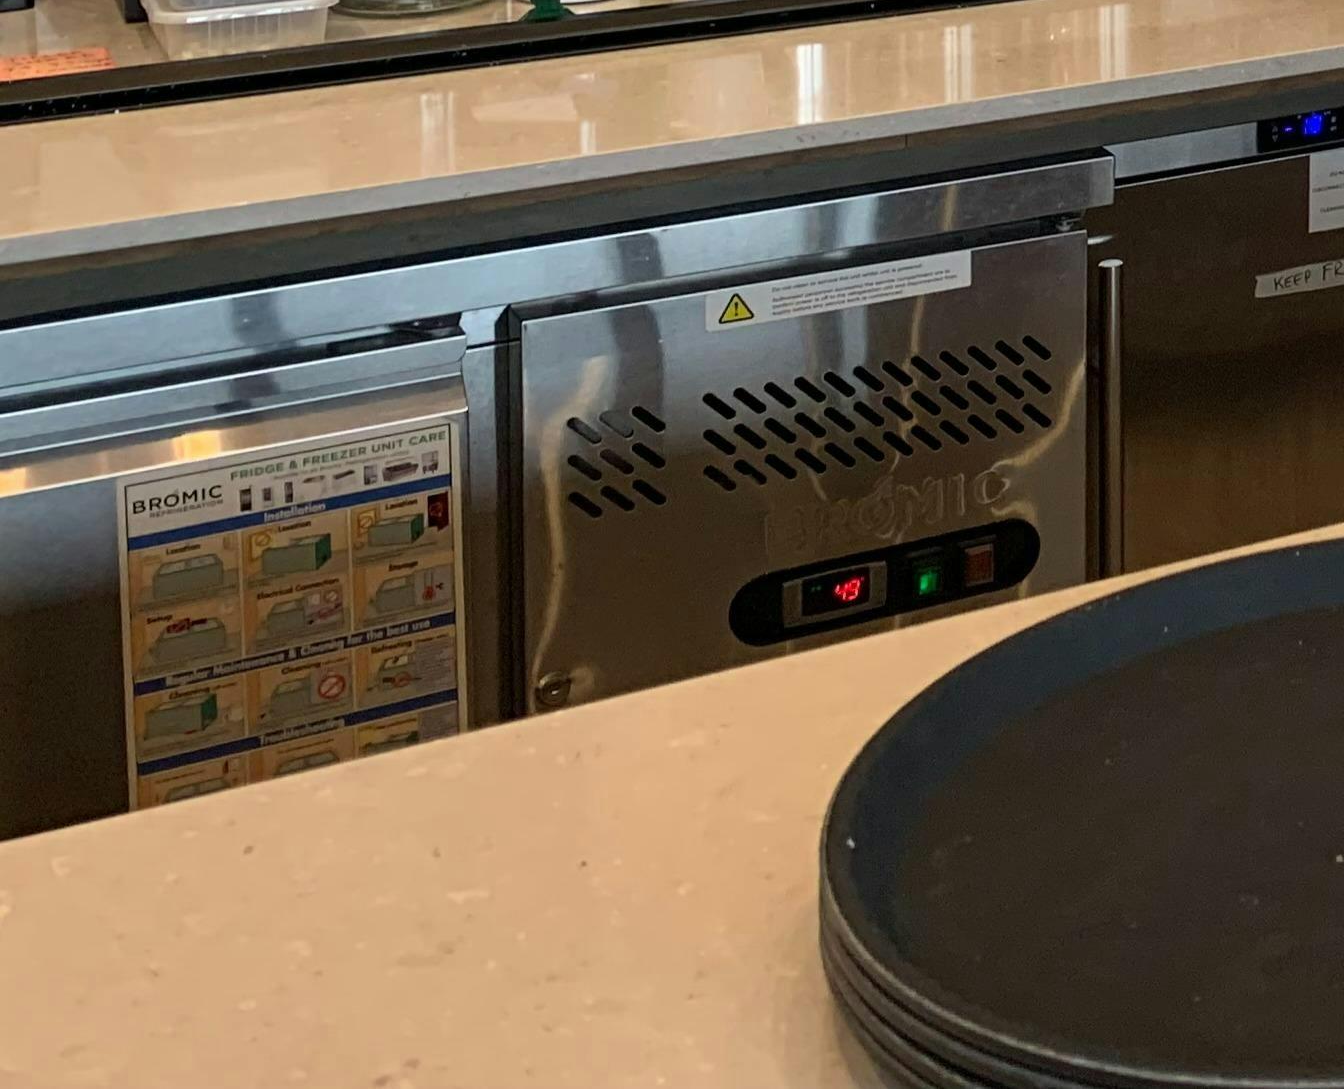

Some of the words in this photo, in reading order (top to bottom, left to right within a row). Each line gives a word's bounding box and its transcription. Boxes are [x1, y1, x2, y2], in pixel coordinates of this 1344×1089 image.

[1273, 270, 1312, 291] KEEP
[230, 460, 285, 481] FRIDGE
[302, 446, 367, 467] FREEZER
[371, 438, 404, 454] UNIT
[408, 430, 446, 447] CARE
[132, 484, 223, 514] BROMIC
